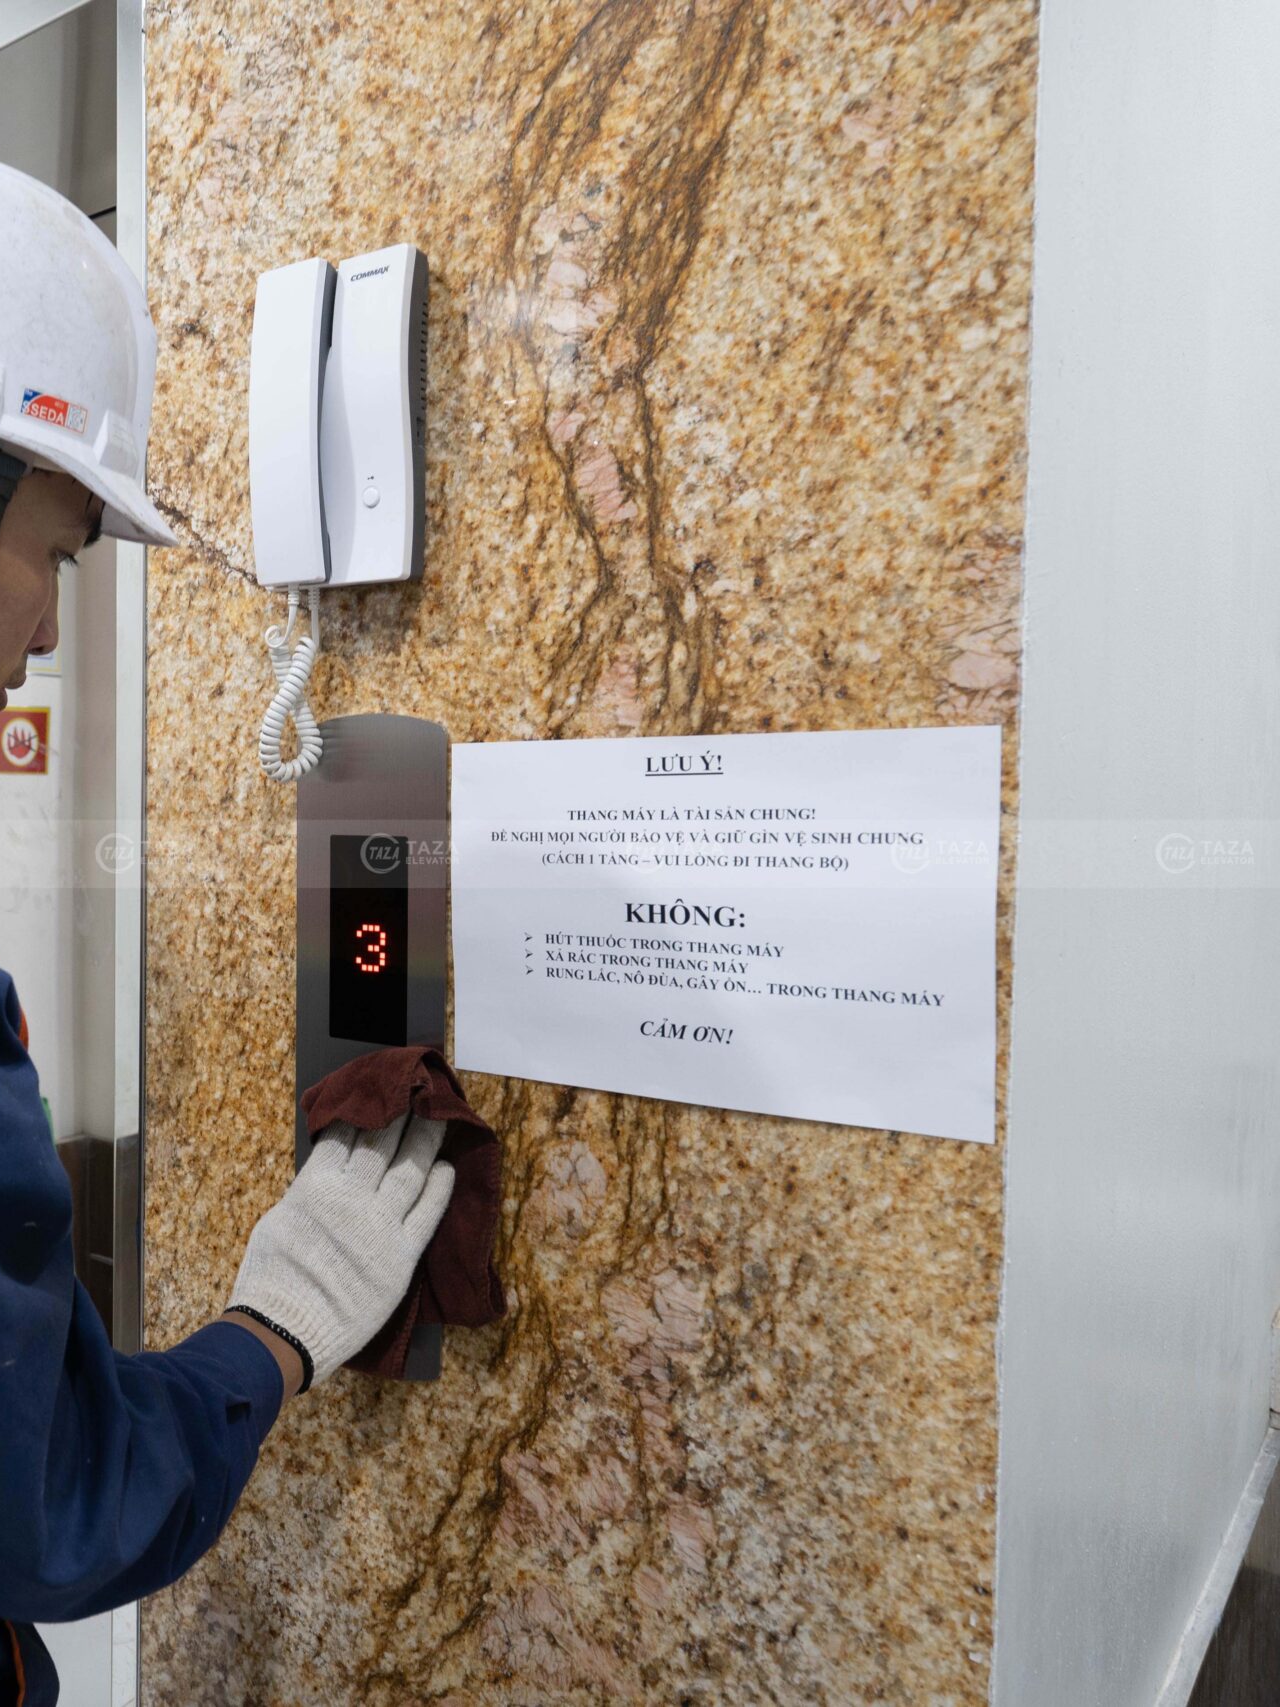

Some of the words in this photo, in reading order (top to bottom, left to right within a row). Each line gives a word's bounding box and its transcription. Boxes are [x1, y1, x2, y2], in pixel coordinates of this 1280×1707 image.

[646, 753, 693, 773] LƯU
[700, 750, 722, 771] Ý!
[568, 809, 618, 821] THANG
[622, 806, 655, 821] MÁY
[660, 806, 680, 821] LÀ
[684, 806, 711, 821] TÀI
[714, 806, 746, 821] SẢN
[750, 808, 816, 821] CHUNG!
[511, 831, 544, 845] NGHỊ
[547, 831, 574, 846] MỌI
[579, 829, 625, 843] NGƯỜI
[630, 829, 661, 843] BẢO
[665, 830, 685, 846] VỆ
[689, 828, 710, 844] VÀ
[714, 829, 747, 844] GIỮ
[749, 829, 779, 844] GÌN
[784, 831, 806, 847] VỆ
[811, 832, 852, 845] SINH
[857, 832, 924, 845] CHUNG
[542, 851, 585, 866] (CÁCH
[588, 854, 594, 865] 1
[655, 854, 680, 866] VUI
[684, 853, 729, 867] LÒNG
[733, 855, 750, 867] ĐI
[754, 856, 814, 869] THANG
[820, 856, 850, 872] BỘ)
[624, 898, 745, 928] KHÔNG:
[355, 924, 387, 972] 3
[545, 931, 574, 946] HÚT
[576, 933, 627, 950] THUỐC
[629, 938, 683, 953] TRONG
[686, 941, 743, 956] THANG
[746, 941, 785, 958] MÁY
[545, 948, 564, 963] XẢ
[568, 948, 597, 964] RÁC
[599, 953, 651, 968] TRONG
[655, 957, 708, 972] THANG
[713, 958, 749, 974] MÁY
[546, 966, 585, 981] RUNG
[623, 970, 645, 985] NÔ
[687, 974, 720, 991] GÂY
[767, 982, 827, 999] TRONG
[832, 987, 896, 1004] THANG
[901, 989, 945, 1007] MÁY
[640, 1017, 687, 1040] CẢM
[693, 1026, 734, 1045] ƠN!
